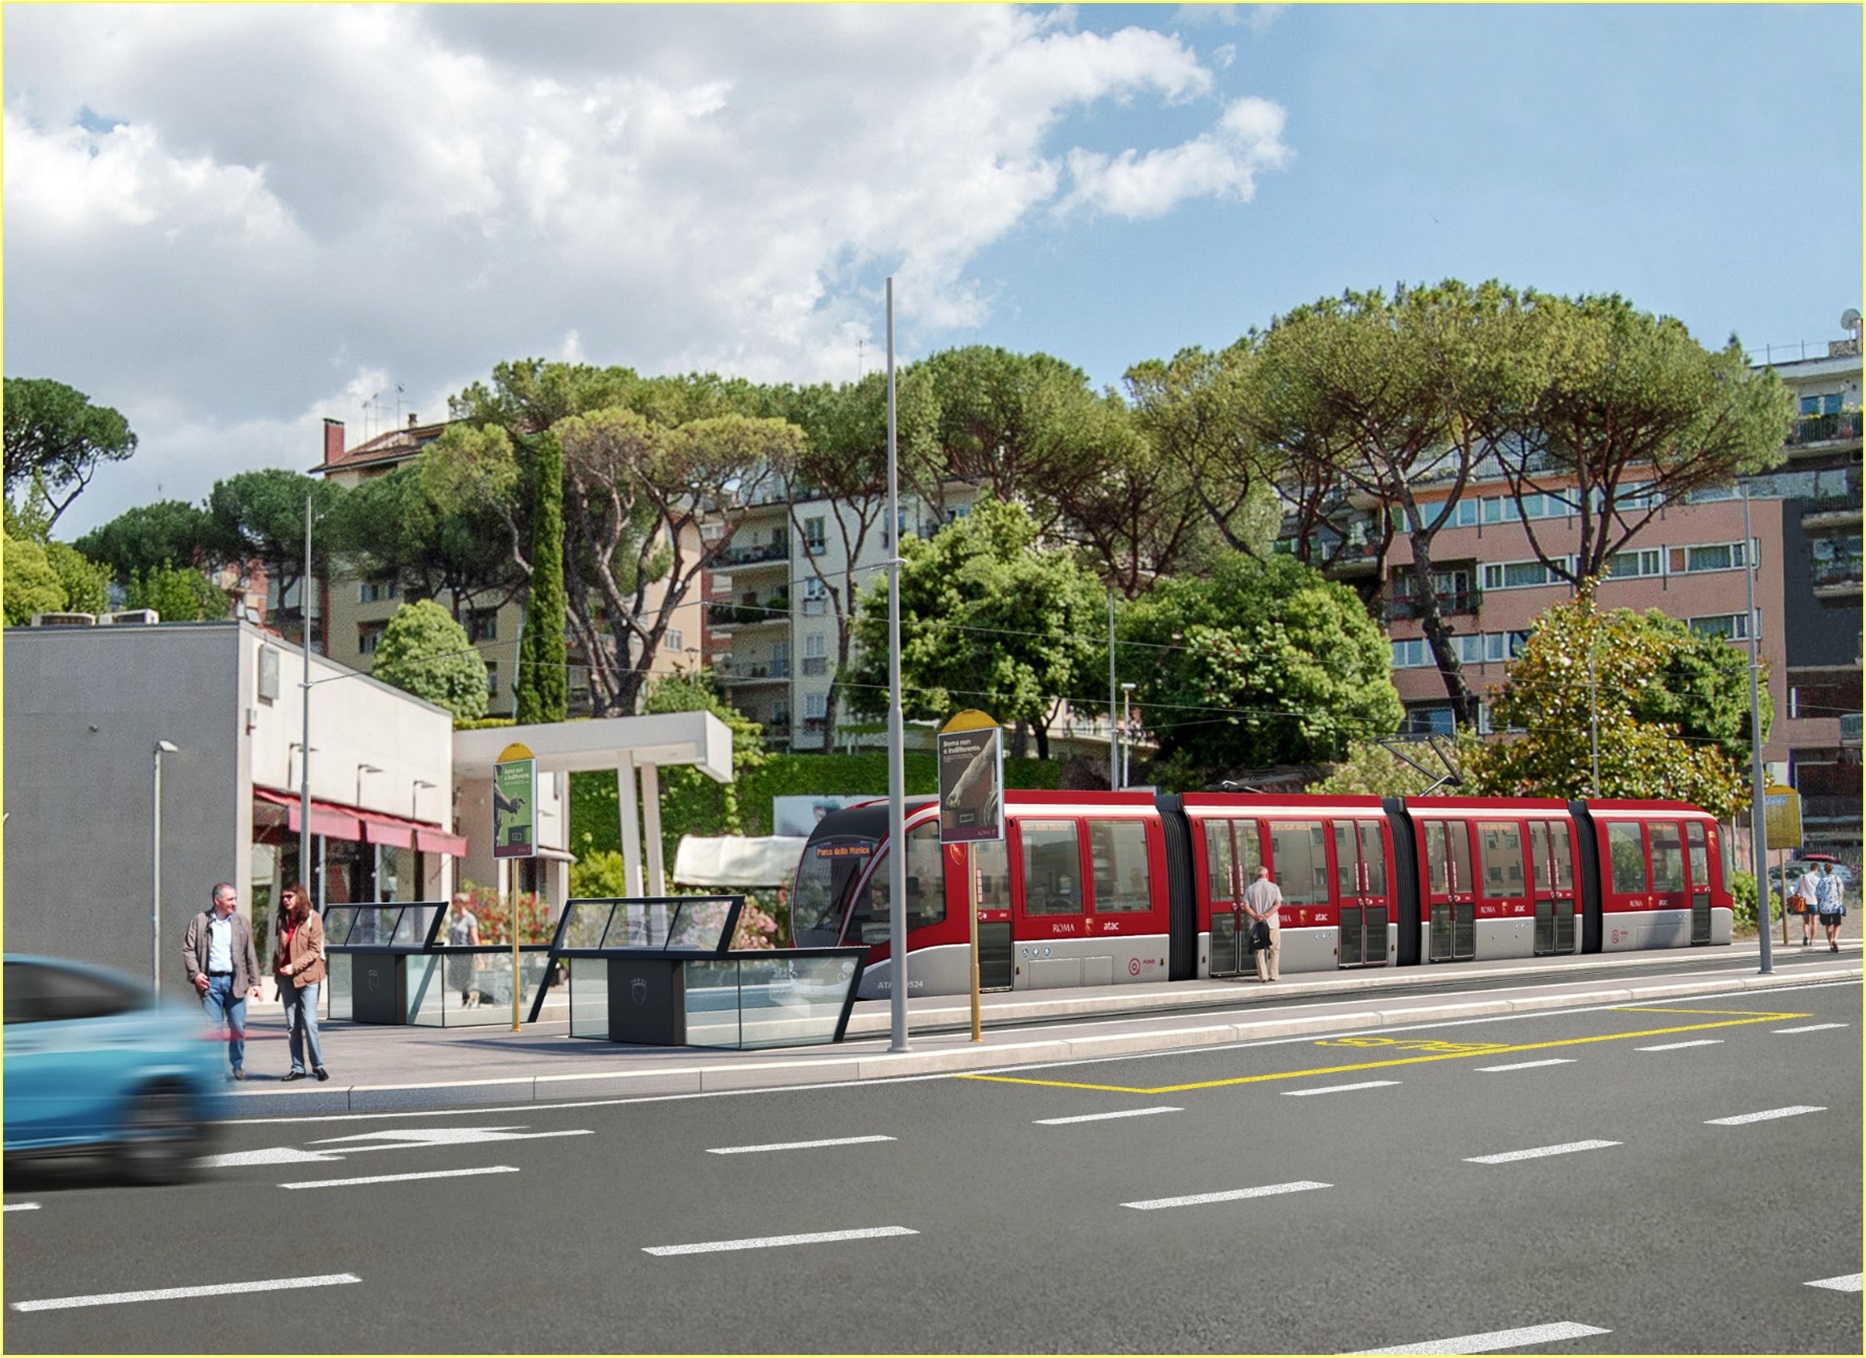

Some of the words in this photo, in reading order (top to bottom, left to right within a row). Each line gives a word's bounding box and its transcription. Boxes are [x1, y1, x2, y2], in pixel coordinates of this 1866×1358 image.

[1315, 913, 1328, 921] atac
[1053, 923, 1075, 932] ROMA
[1103, 921, 1119, 931] atac
